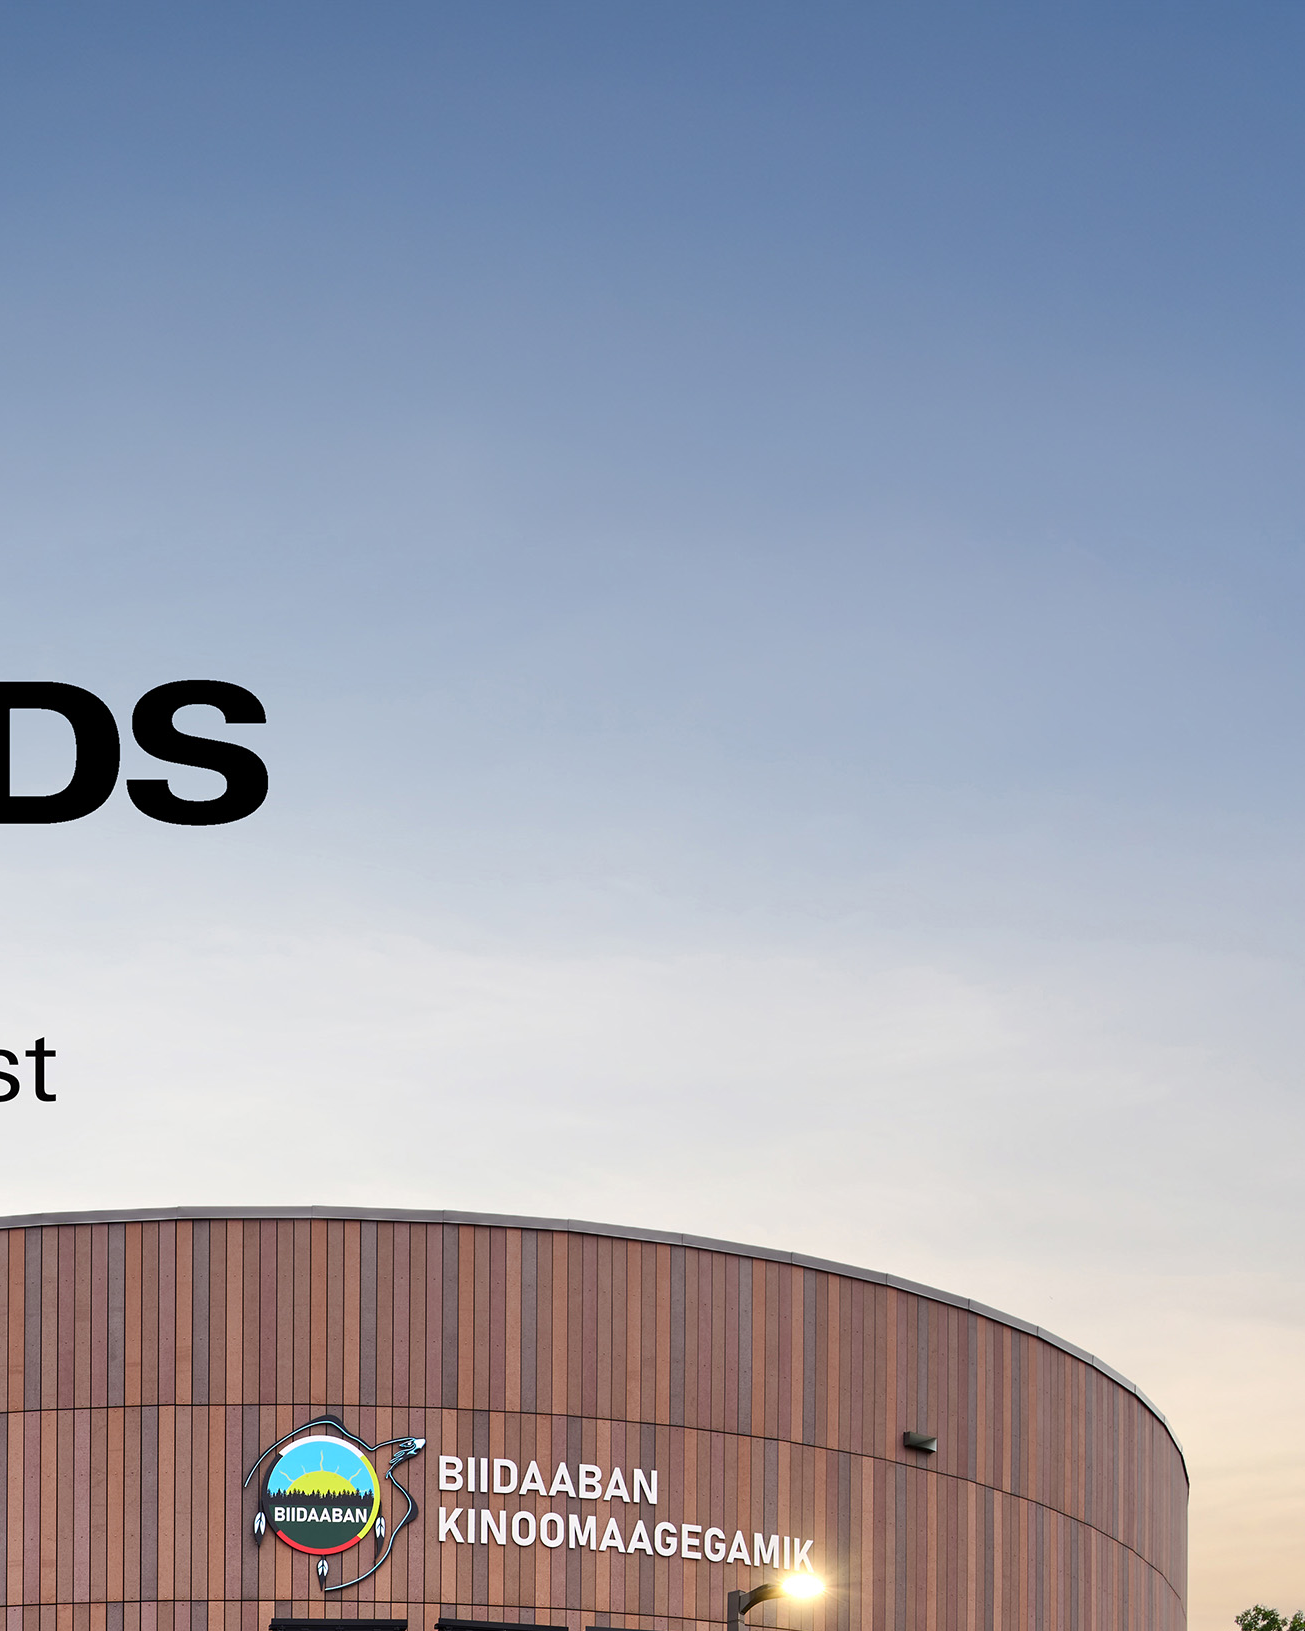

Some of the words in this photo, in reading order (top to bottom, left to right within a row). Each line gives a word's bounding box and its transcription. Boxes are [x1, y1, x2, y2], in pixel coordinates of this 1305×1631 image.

[439, 1455, 658, 1505] BIIDAABAN
[274, 1506, 368, 1524] BIIDAABAN
[438, 1506, 815, 1574] KINOOMAAGEGAMIK
